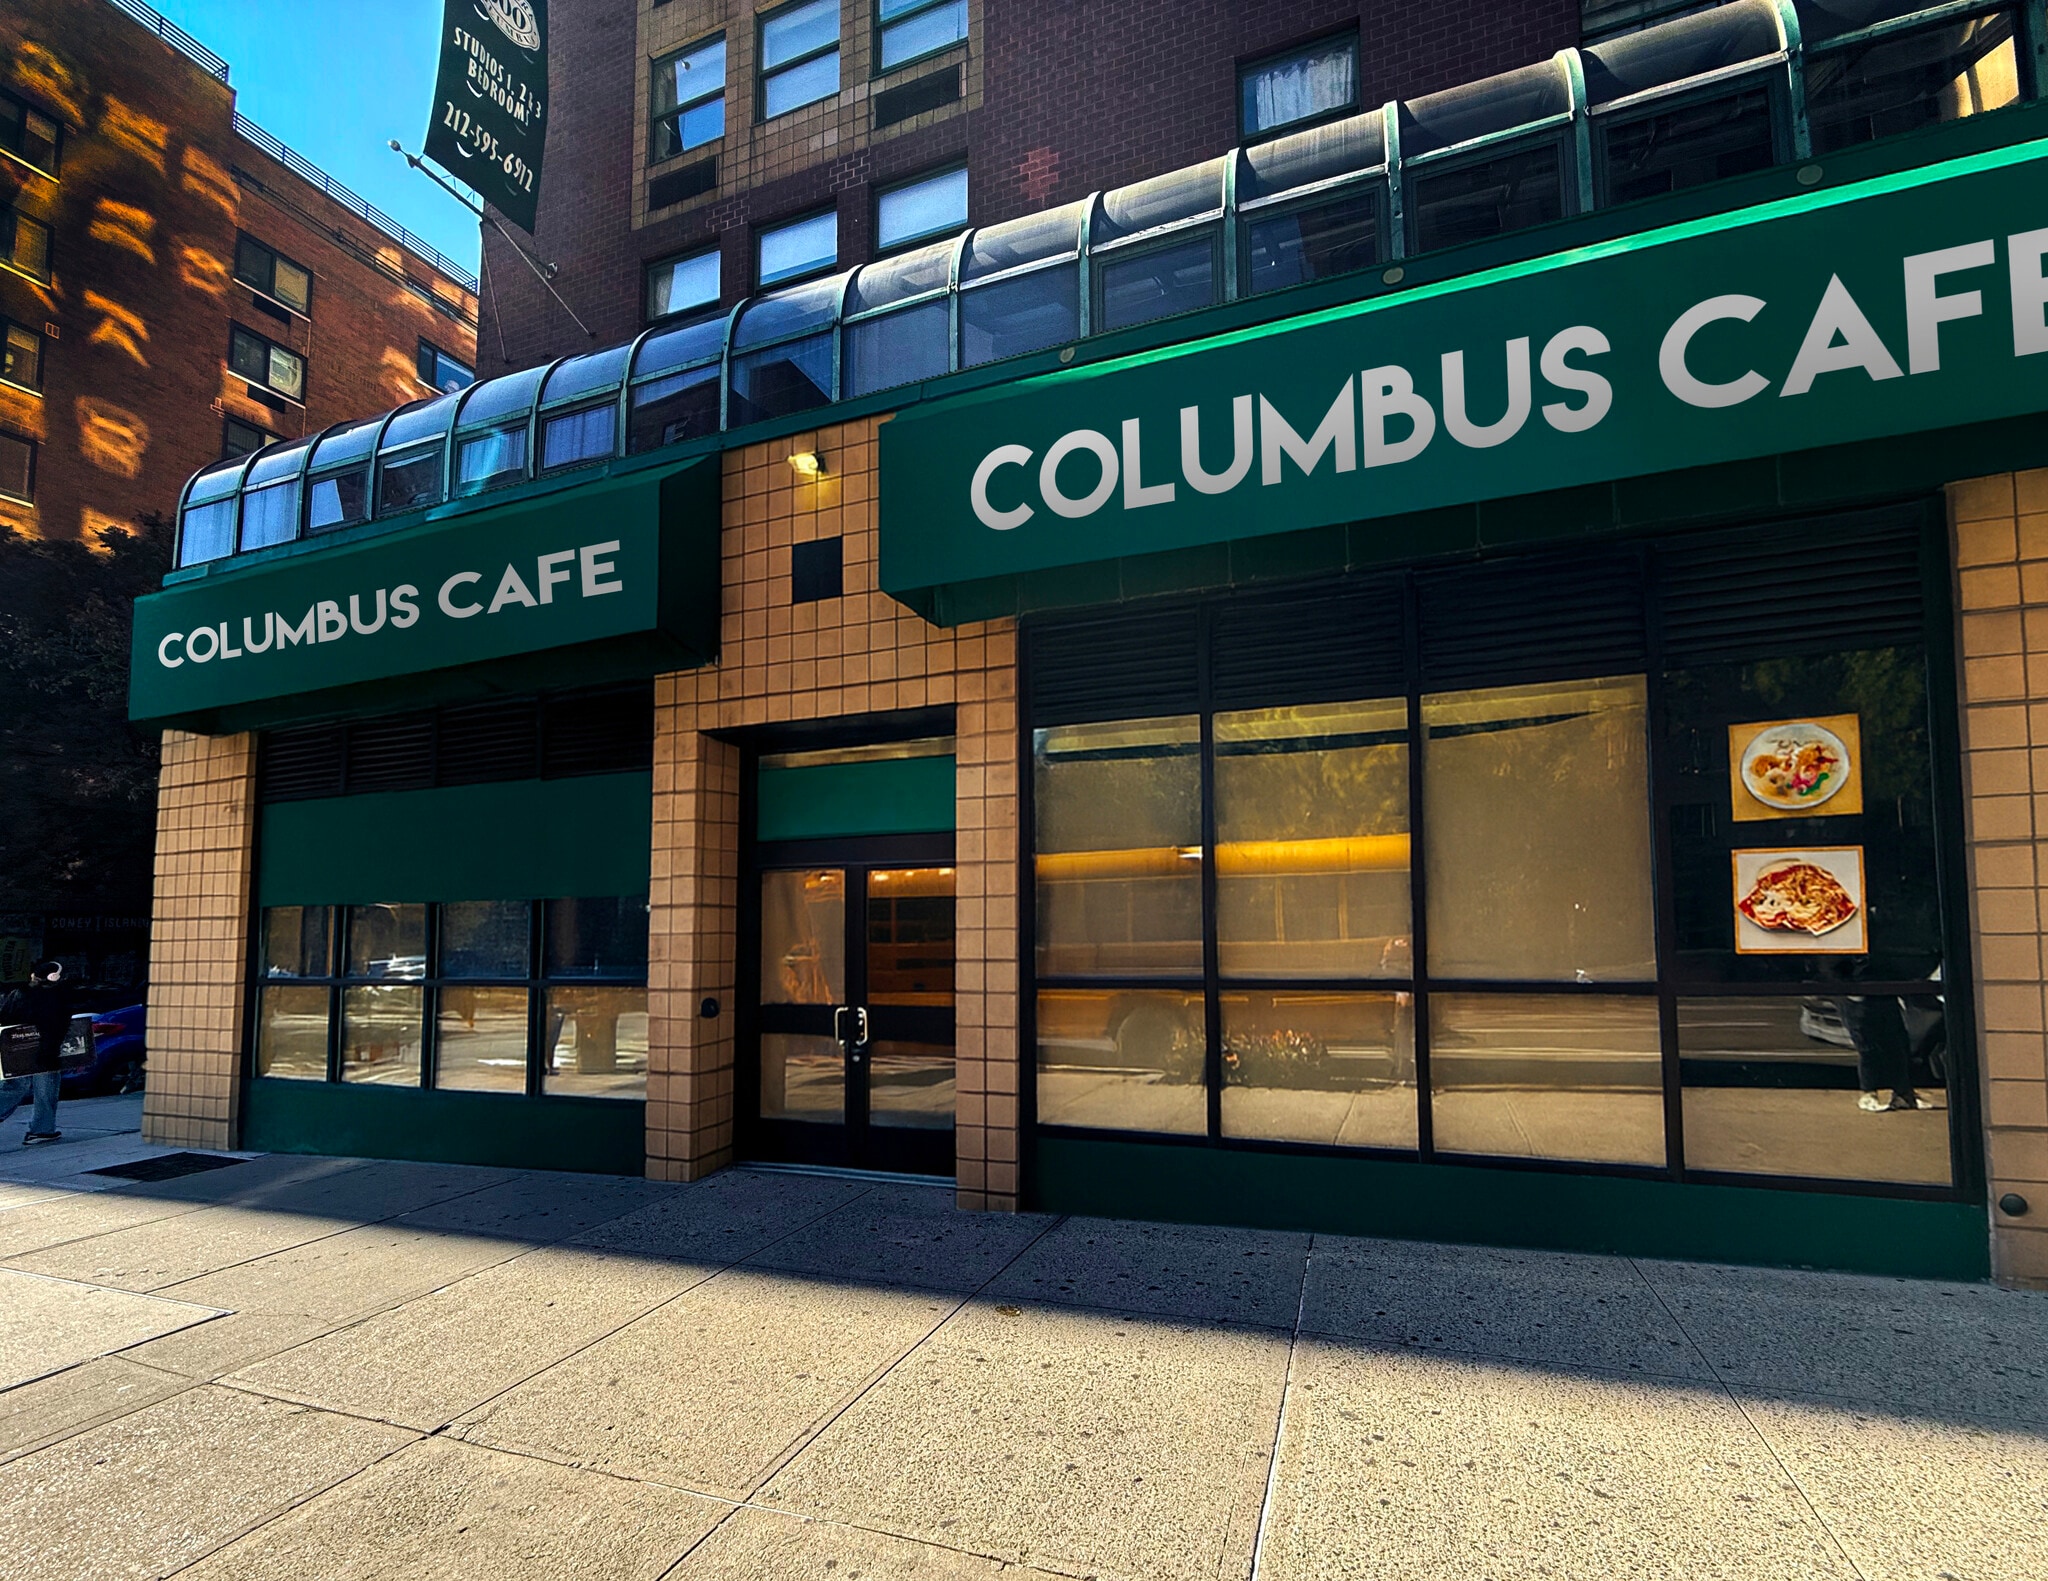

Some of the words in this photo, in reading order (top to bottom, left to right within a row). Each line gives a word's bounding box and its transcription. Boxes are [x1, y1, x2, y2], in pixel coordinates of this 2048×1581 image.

[454, 26, 504, 83] STUDIOS
[519, 83, 527, 102] 2
[535, 101, 542, 119] 3
[467, 57, 530, 127] BEDROOMS
[443, 101, 534, 193] 212-595-6912
[970, 324, 1614, 531] COLUMBUS
[158, 583, 420, 668] COLUMBUS
[437, 539, 623, 619] CAFE
[51, 916, 92, 929] CONEY
